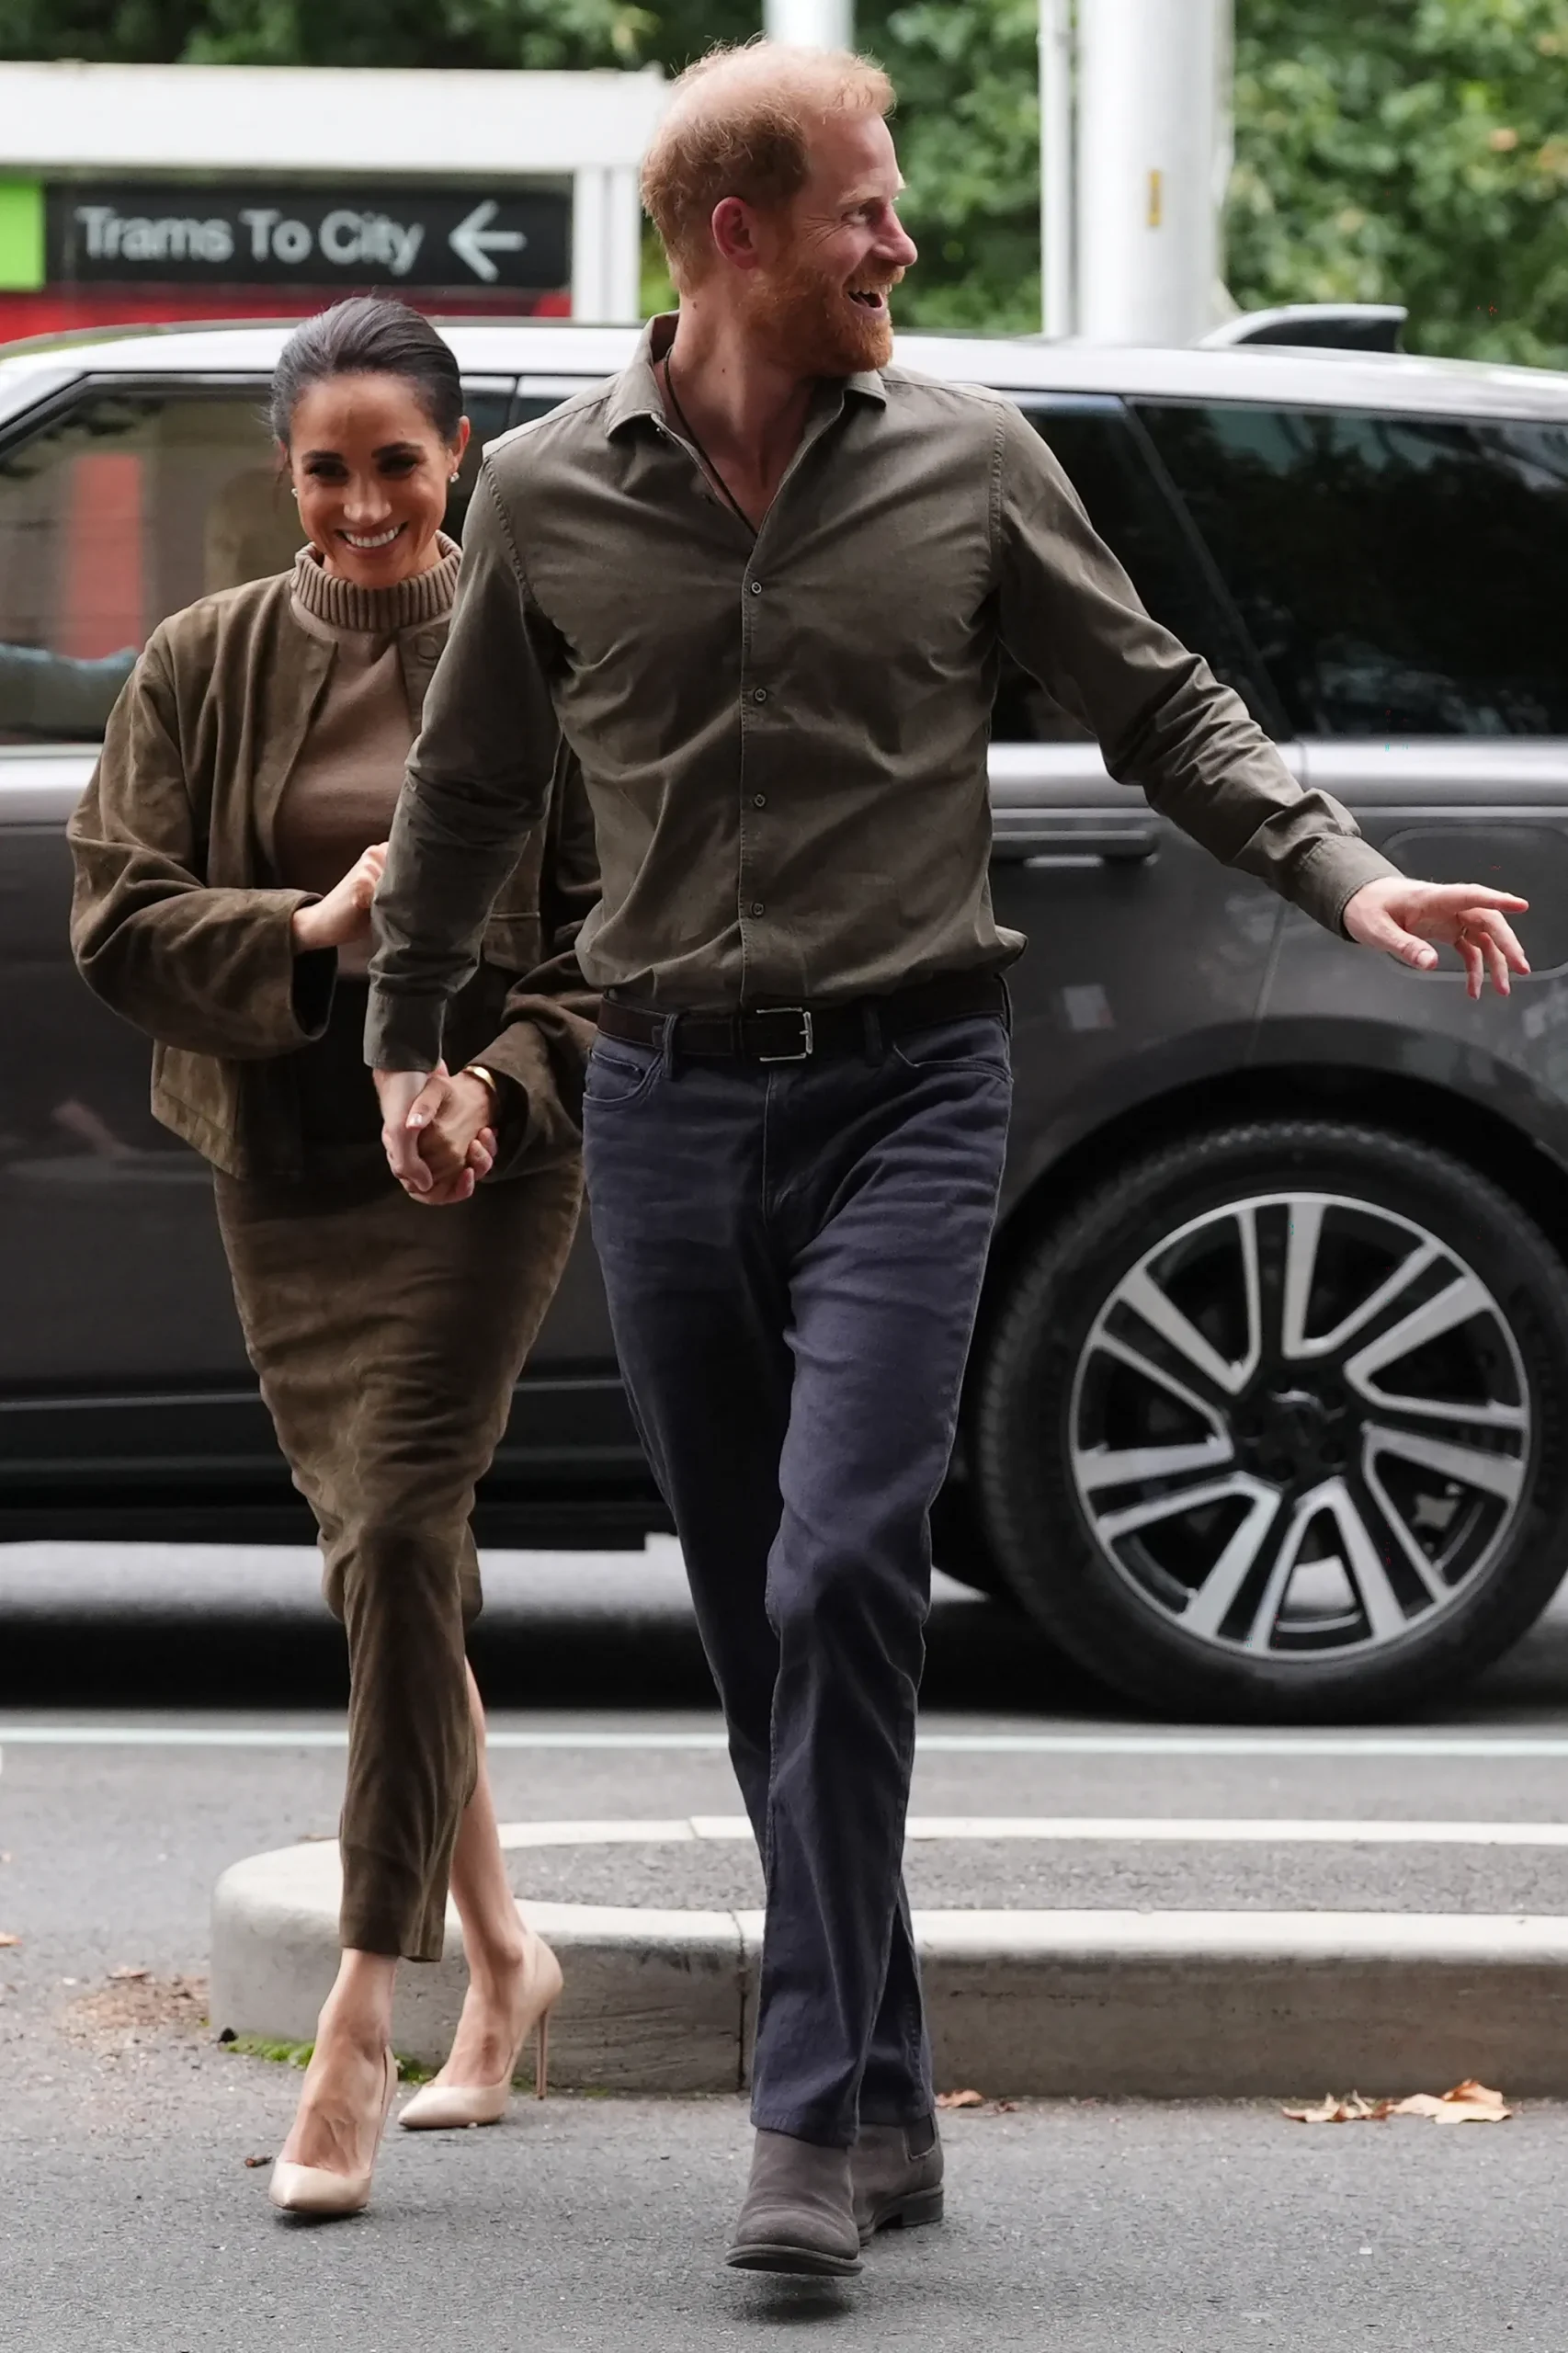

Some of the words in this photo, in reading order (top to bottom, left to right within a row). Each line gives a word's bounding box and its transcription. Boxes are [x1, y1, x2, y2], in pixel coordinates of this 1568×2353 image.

[75, 206, 234, 261] Trams
[241, 209, 311, 263] To
[318, 210, 424, 275] City
